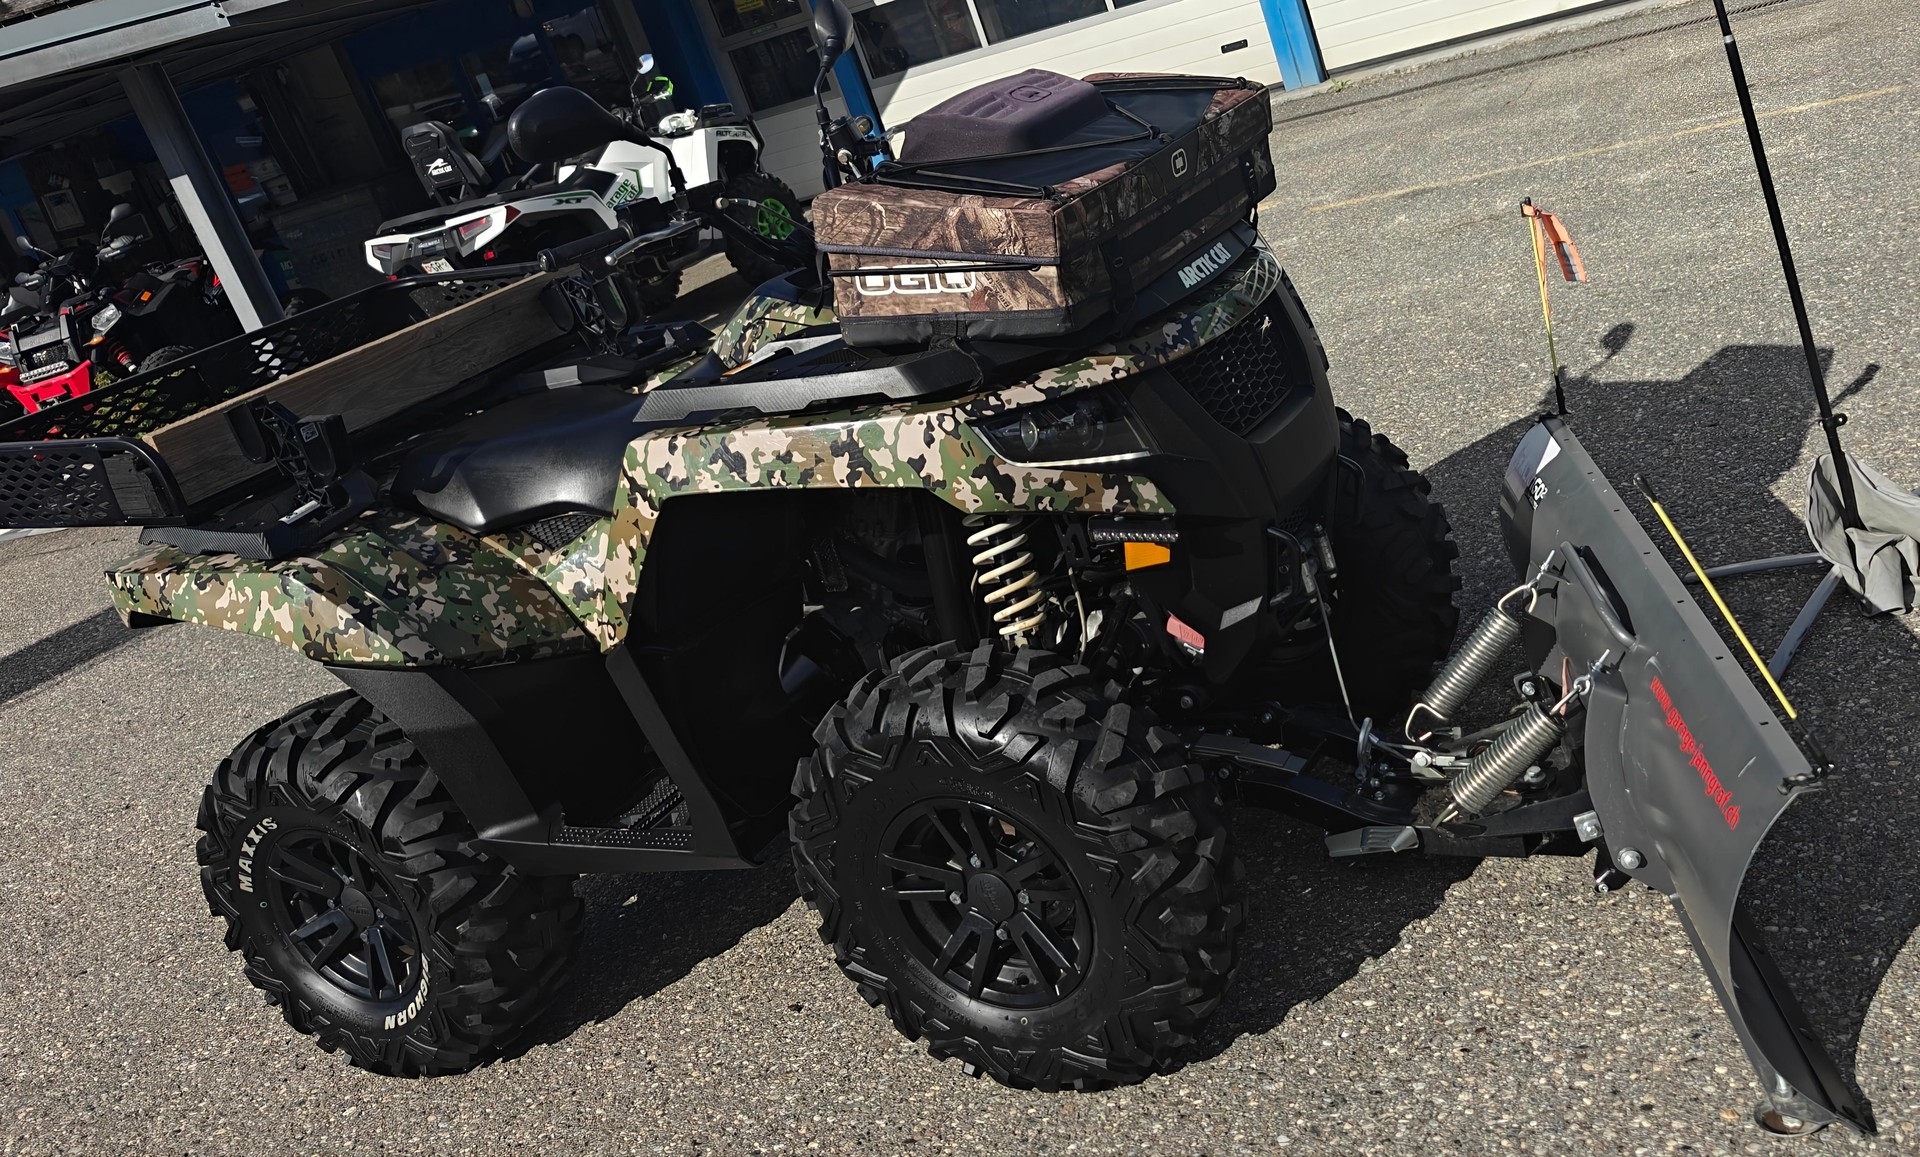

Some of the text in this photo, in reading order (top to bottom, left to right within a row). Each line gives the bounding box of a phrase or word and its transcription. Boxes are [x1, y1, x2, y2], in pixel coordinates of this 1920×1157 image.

[1177, 241, 1232, 289] ARCTIC CAT
[1649, 675, 1741, 831] www.garage-janngraf.ch
[238, 816, 278, 893] MAXXIS
[384, 952, 429, 1031] BIGHORN
